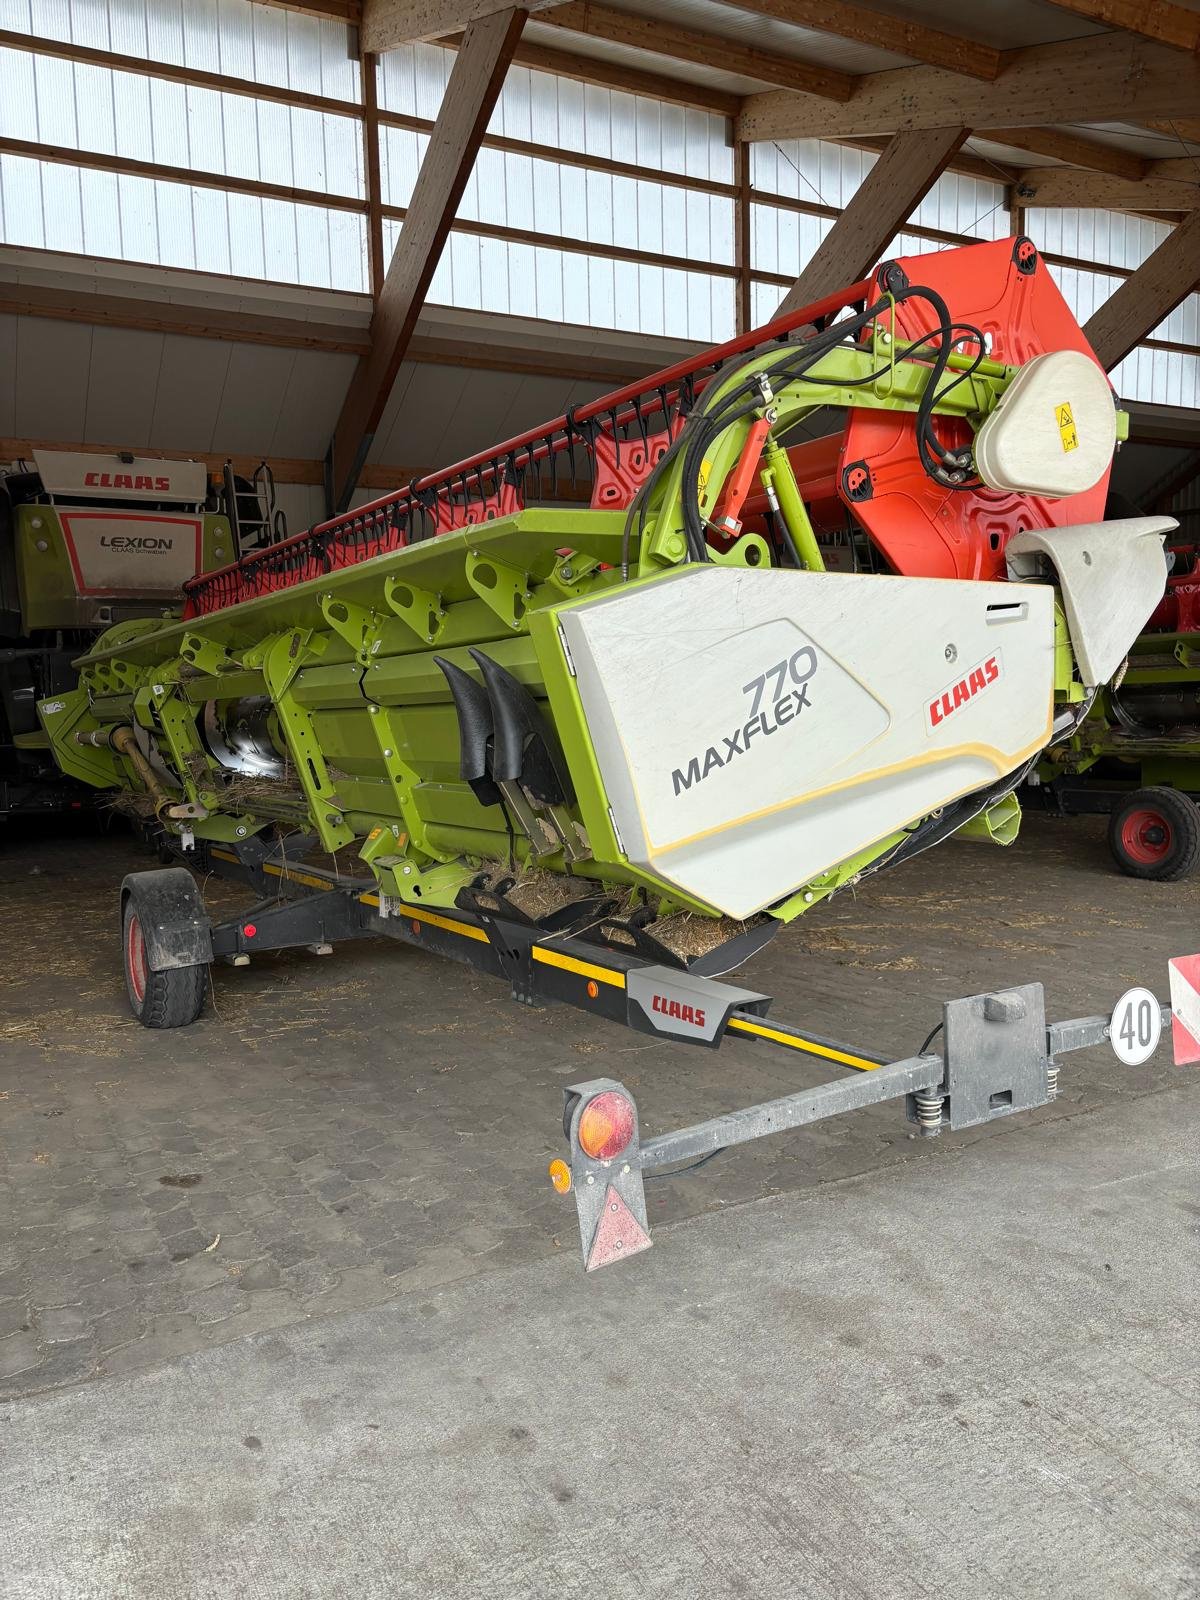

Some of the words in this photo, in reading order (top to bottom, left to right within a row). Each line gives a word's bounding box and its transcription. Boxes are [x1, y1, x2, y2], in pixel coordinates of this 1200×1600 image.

[84, 472, 170, 491] CLAAS
[100, 536, 173, 550] LEXION
[742, 645, 818, 719] 770
[929, 656, 999, 727] CLAAS
[671, 682, 812, 797] MAXFLEX
[652, 994, 706, 1028] CLAAS
[1119, 999, 1152, 1050] 40
